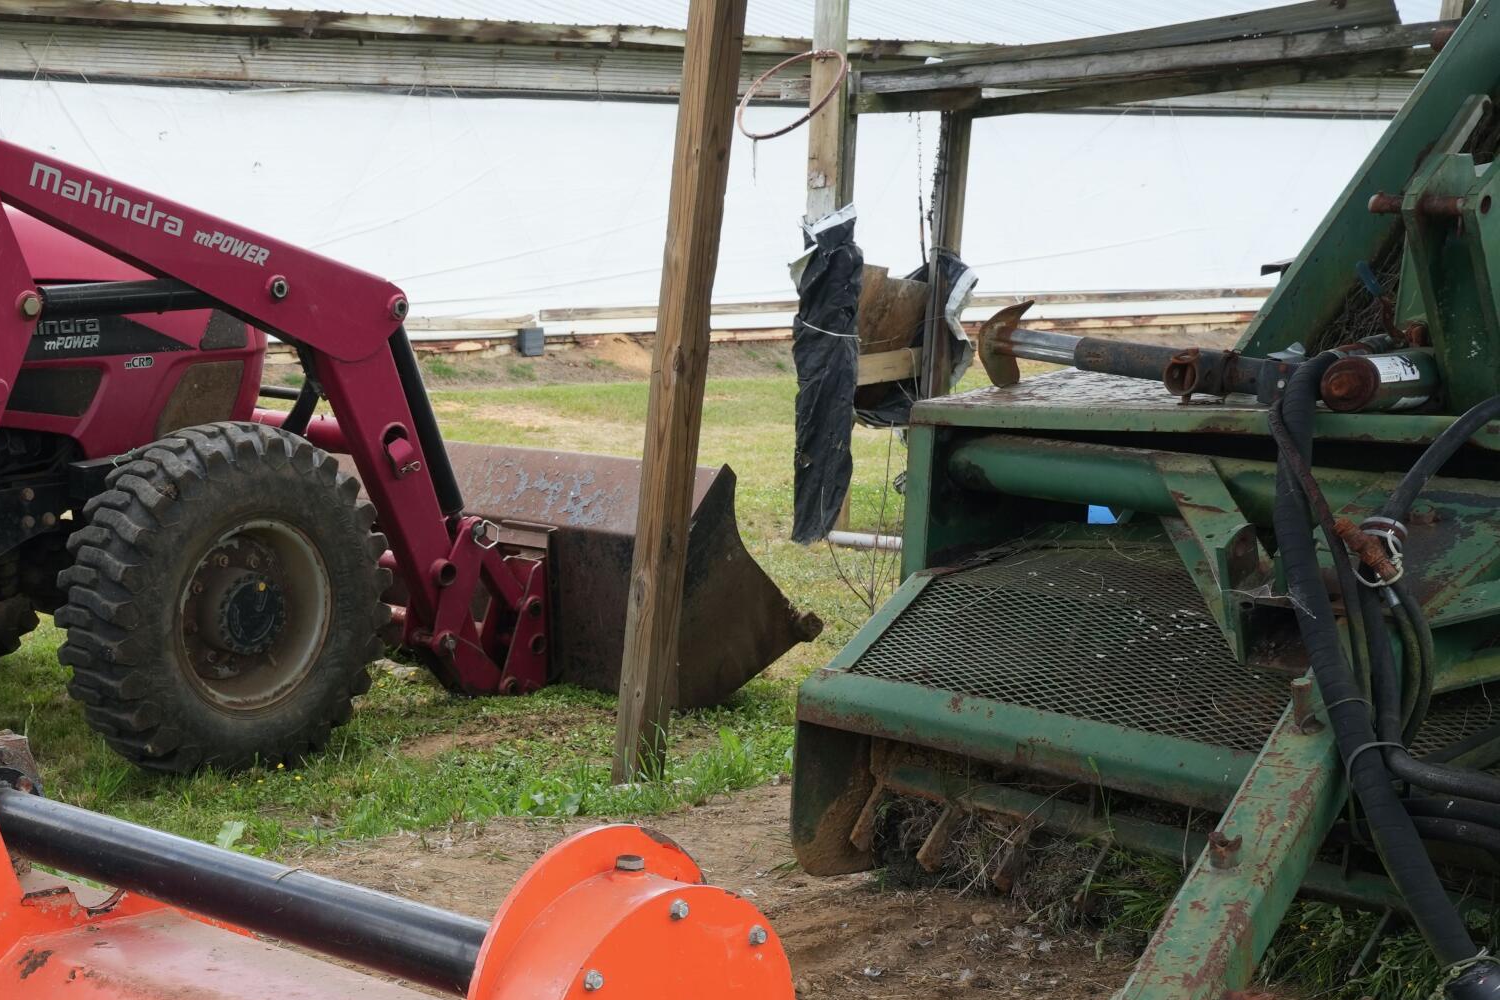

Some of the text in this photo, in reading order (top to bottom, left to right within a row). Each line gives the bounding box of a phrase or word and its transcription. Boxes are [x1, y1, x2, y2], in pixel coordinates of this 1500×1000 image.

[29, 161, 270, 266] Mahindra mPOWER
[34, 318, 100, 335] indra
[44, 335, 100, 351] mPOWER
